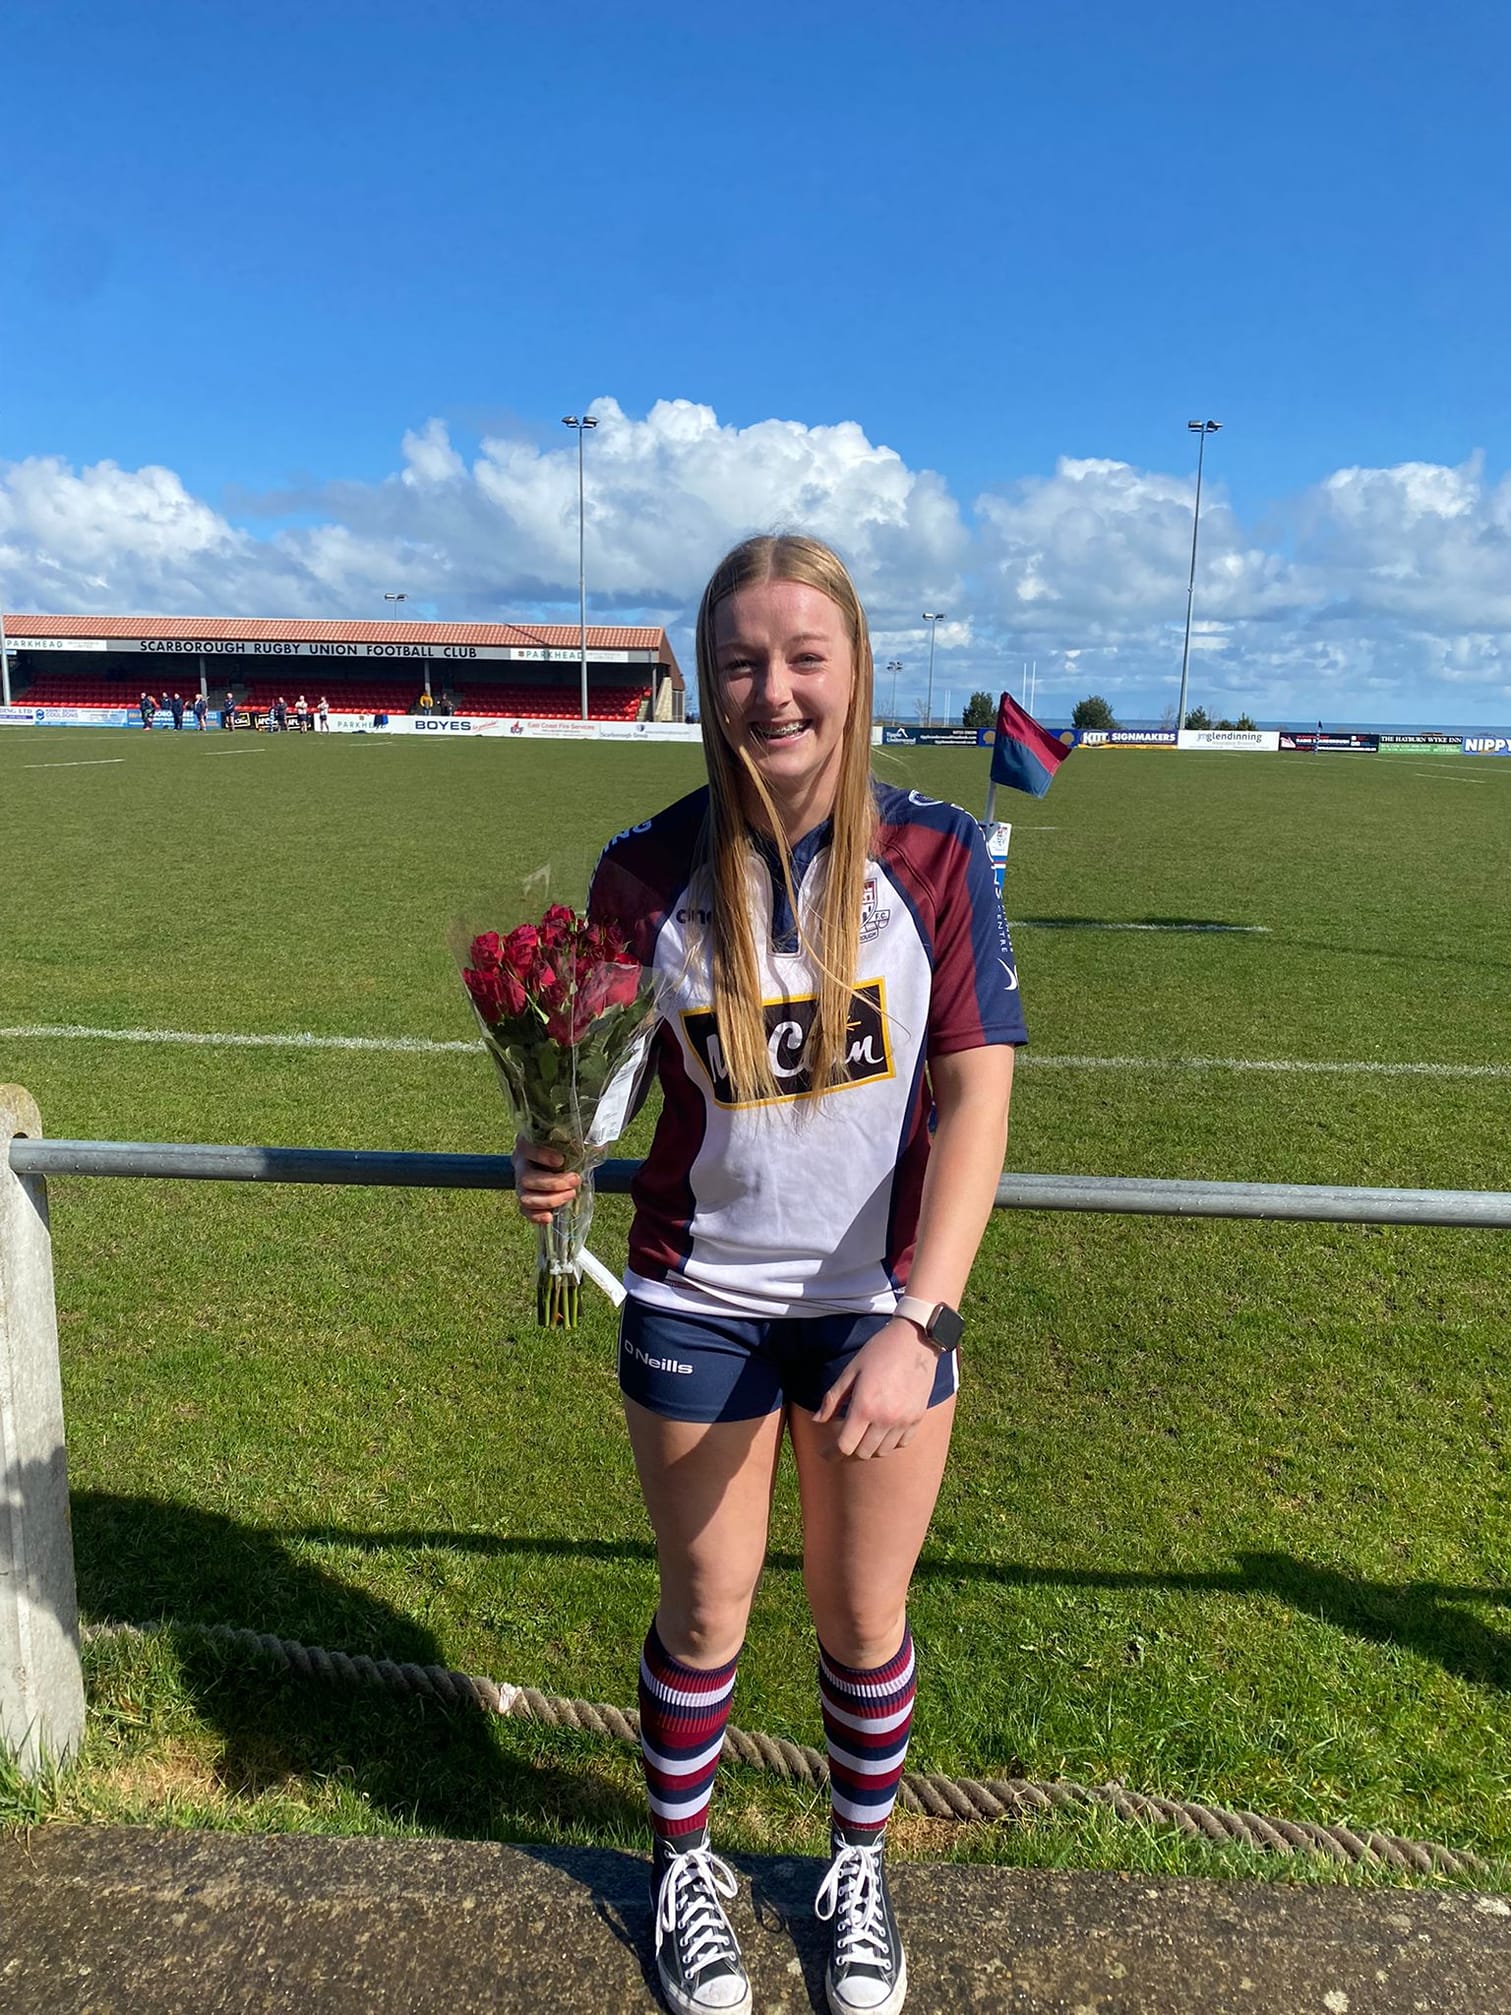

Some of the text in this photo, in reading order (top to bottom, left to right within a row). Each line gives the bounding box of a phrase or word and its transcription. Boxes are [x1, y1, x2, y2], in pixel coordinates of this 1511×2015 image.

[6, 639, 64, 649] PARKHEAD
[140, 640, 477, 658] SCARBOROUGH RUGBY UNION FOOTBALL CLUB
[415, 720, 471, 731] BOYES
[1111, 732, 1176, 742] SIGNMAKERS
